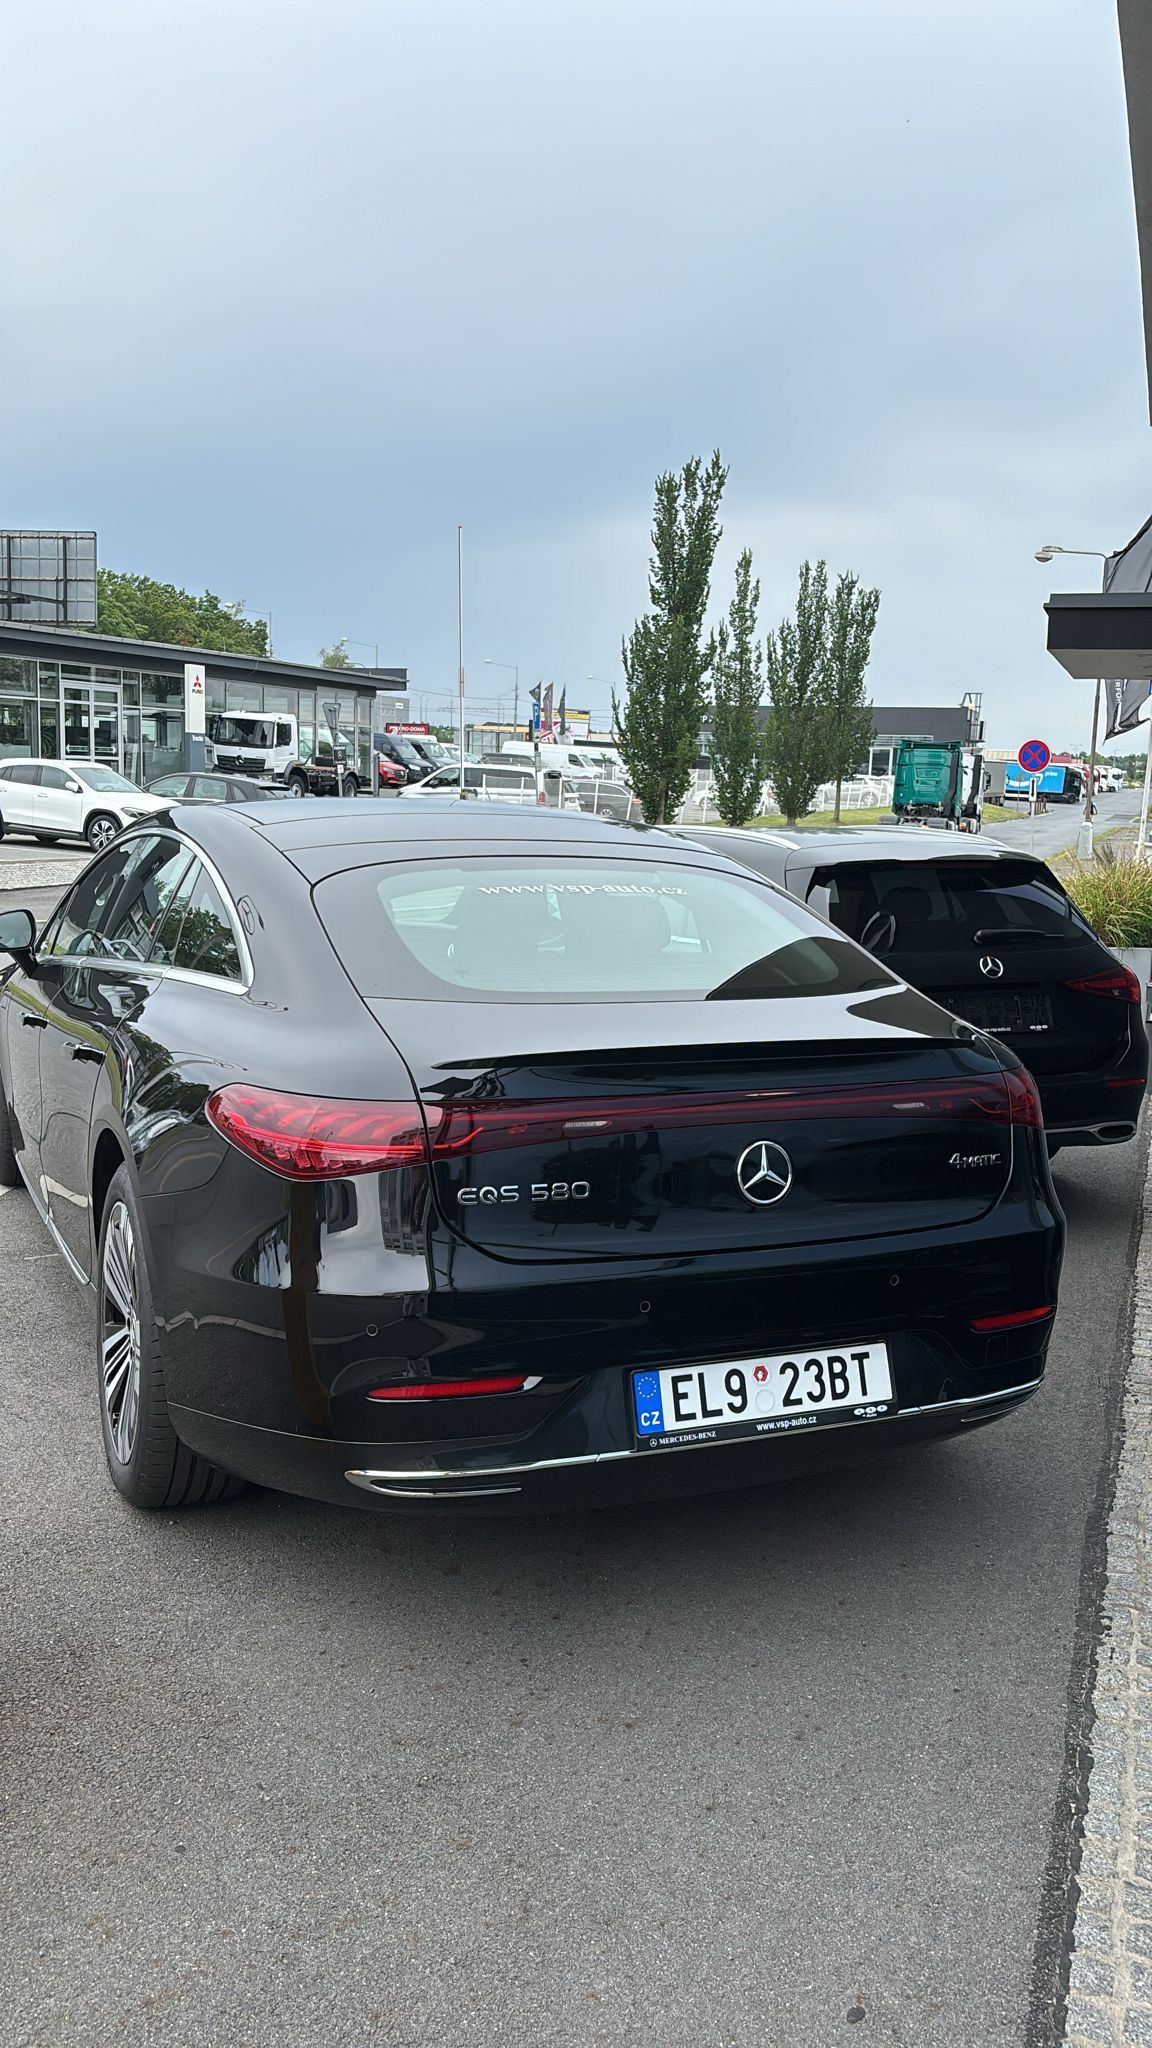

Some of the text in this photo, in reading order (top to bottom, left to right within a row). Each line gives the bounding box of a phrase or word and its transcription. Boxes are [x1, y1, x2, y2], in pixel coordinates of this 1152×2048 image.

[478, 884, 688, 895] www.vsp-auto.cz
[457, 1181, 591, 1206] EQS 580
[671, 1352, 870, 1423] EL9 23BT
[641, 1411, 660, 1426] CZ
[756, 1415, 817, 1432] www.vsp-auto.cz
[659, 1431, 717, 1445] MERCEDES-BENZ
